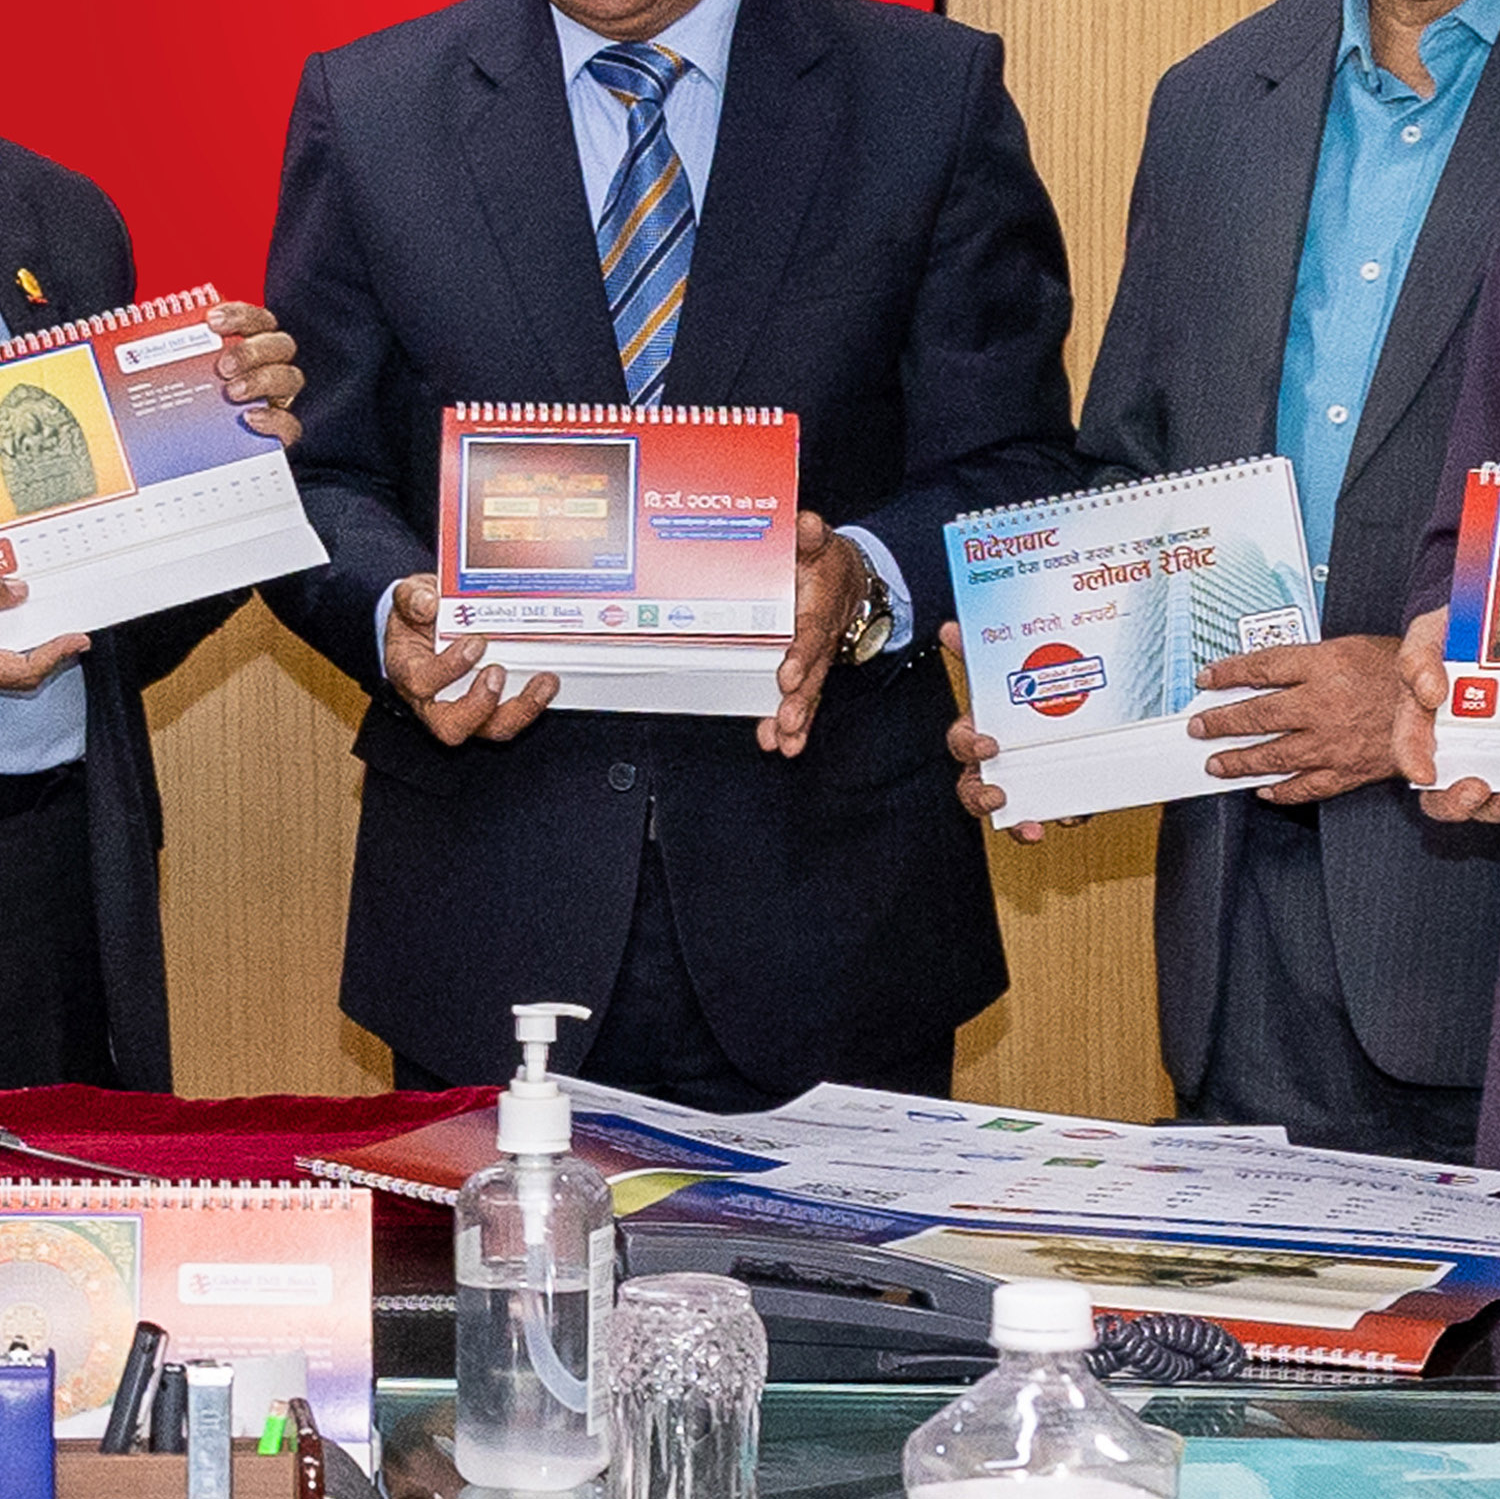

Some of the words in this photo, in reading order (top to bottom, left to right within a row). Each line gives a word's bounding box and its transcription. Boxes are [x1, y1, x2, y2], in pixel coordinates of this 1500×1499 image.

[963, 527, 1061, 564] विदेशबाट
[1072, 559, 1151, 592] ग्लोबल
[1157, 545, 1217, 576] रेमिट
